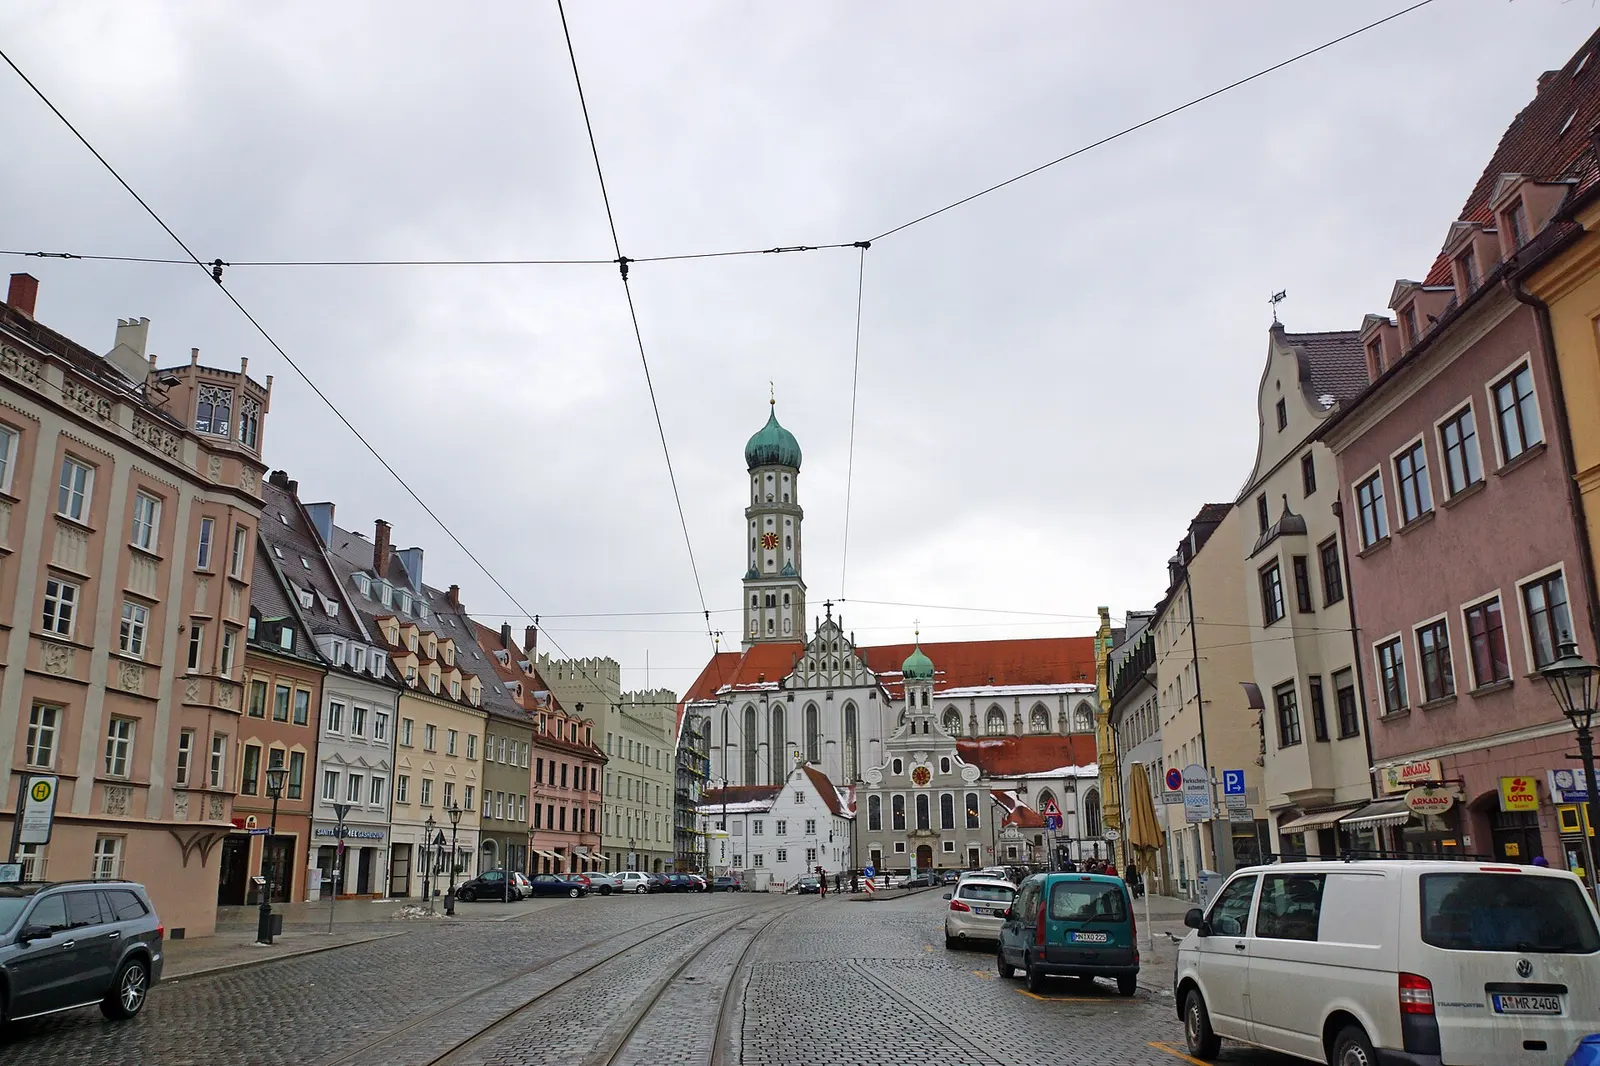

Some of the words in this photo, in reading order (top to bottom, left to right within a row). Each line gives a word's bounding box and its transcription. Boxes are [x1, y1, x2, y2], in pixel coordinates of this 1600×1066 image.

[1227, 773, 1238, 792] P
[36, 785, 46, 797] H
[1507, 794, 1534, 802] LOTTO
[1502, 996, 1509, 1009] A
[1514, 997, 1531, 1009] MR
[1531, 997, 1558, 1010] 2406
